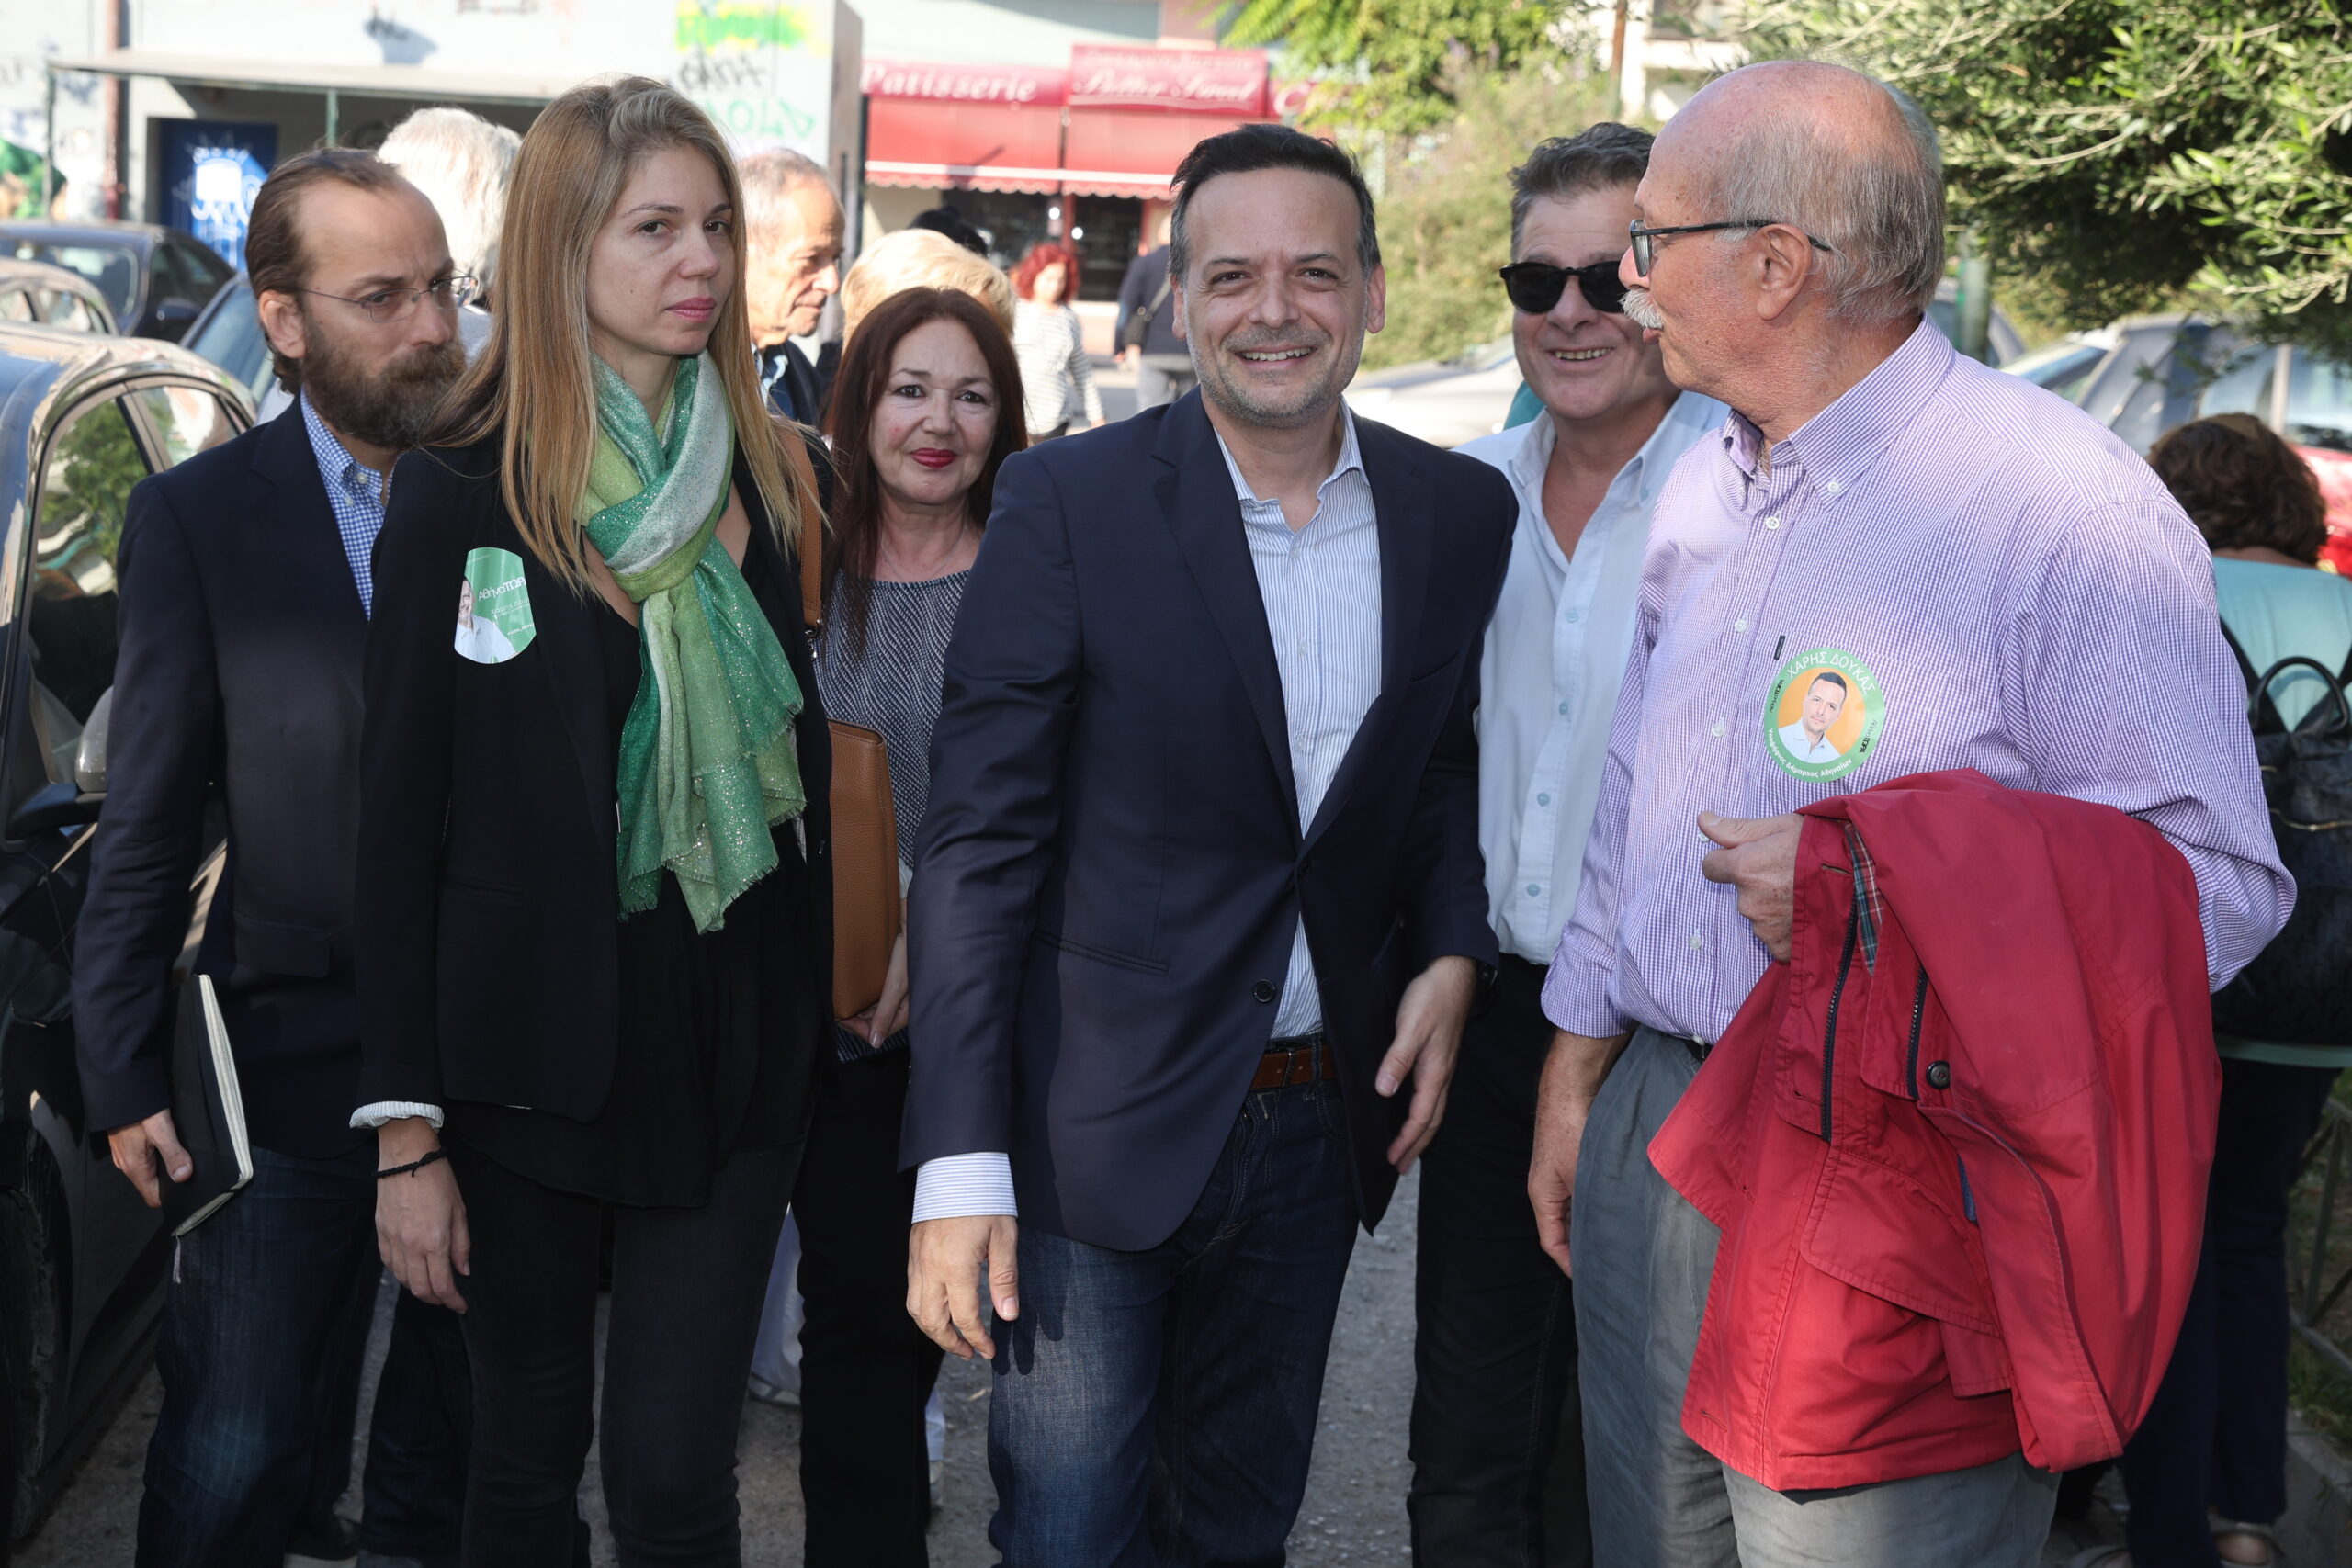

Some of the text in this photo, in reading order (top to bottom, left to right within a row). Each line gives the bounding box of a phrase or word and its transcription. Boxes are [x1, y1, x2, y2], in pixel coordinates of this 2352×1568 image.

[859, 62, 1036, 102] Patisserie
[1787, 652, 1875, 695] ΧΑΡΗΣ ΔΟΥΚΑΣ
[1786, 762, 1819, 778] Δήμαρχος
[1820, 758, 1852, 777] Αθηναίων
